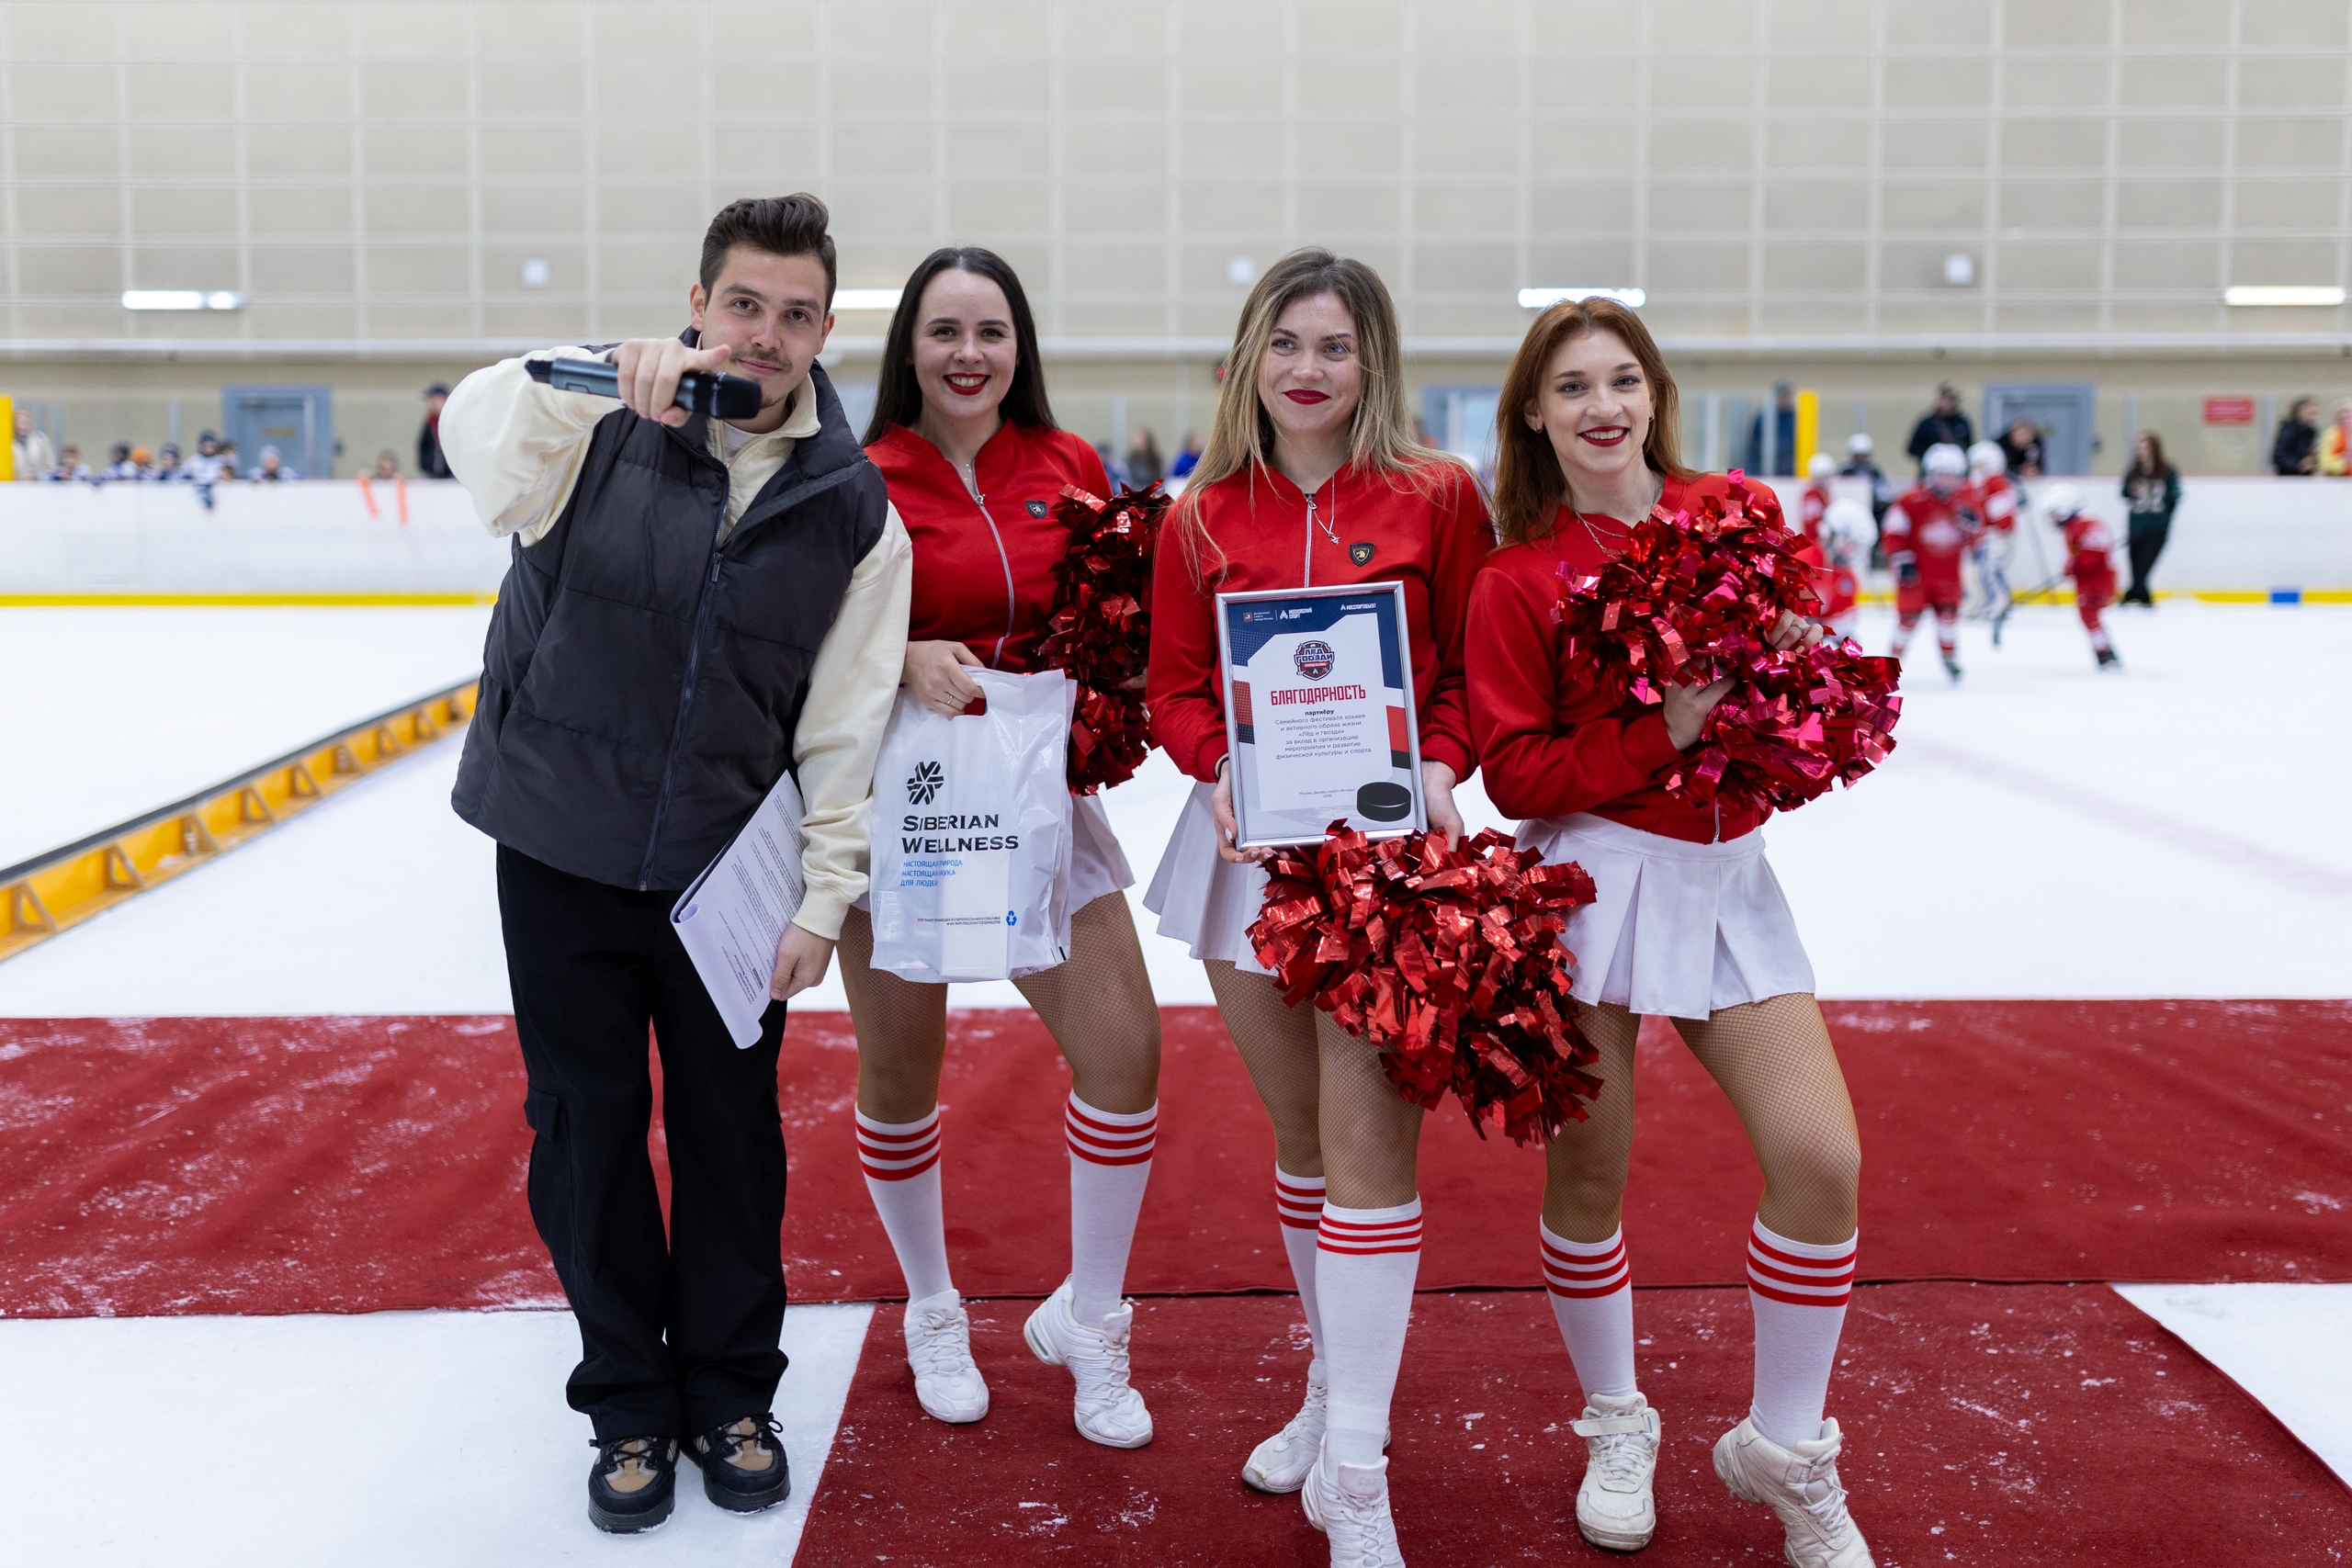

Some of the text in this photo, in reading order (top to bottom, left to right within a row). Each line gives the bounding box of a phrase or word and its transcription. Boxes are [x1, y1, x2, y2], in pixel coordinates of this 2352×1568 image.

[1270, 684, 1366, 705] БЛАГОДАРНОСТЬ
[1309, 716, 1343, 724] фестиваля
[1318, 735, 1359, 743] организацию
[1284, 744, 1326, 752] мероприятия
[1275, 751, 1313, 760] физической
[901, 813, 1000, 831] SIBERIAN
[900, 835, 1019, 854] WELLNESS
[899, 879, 914, 887] ДЛЯ
